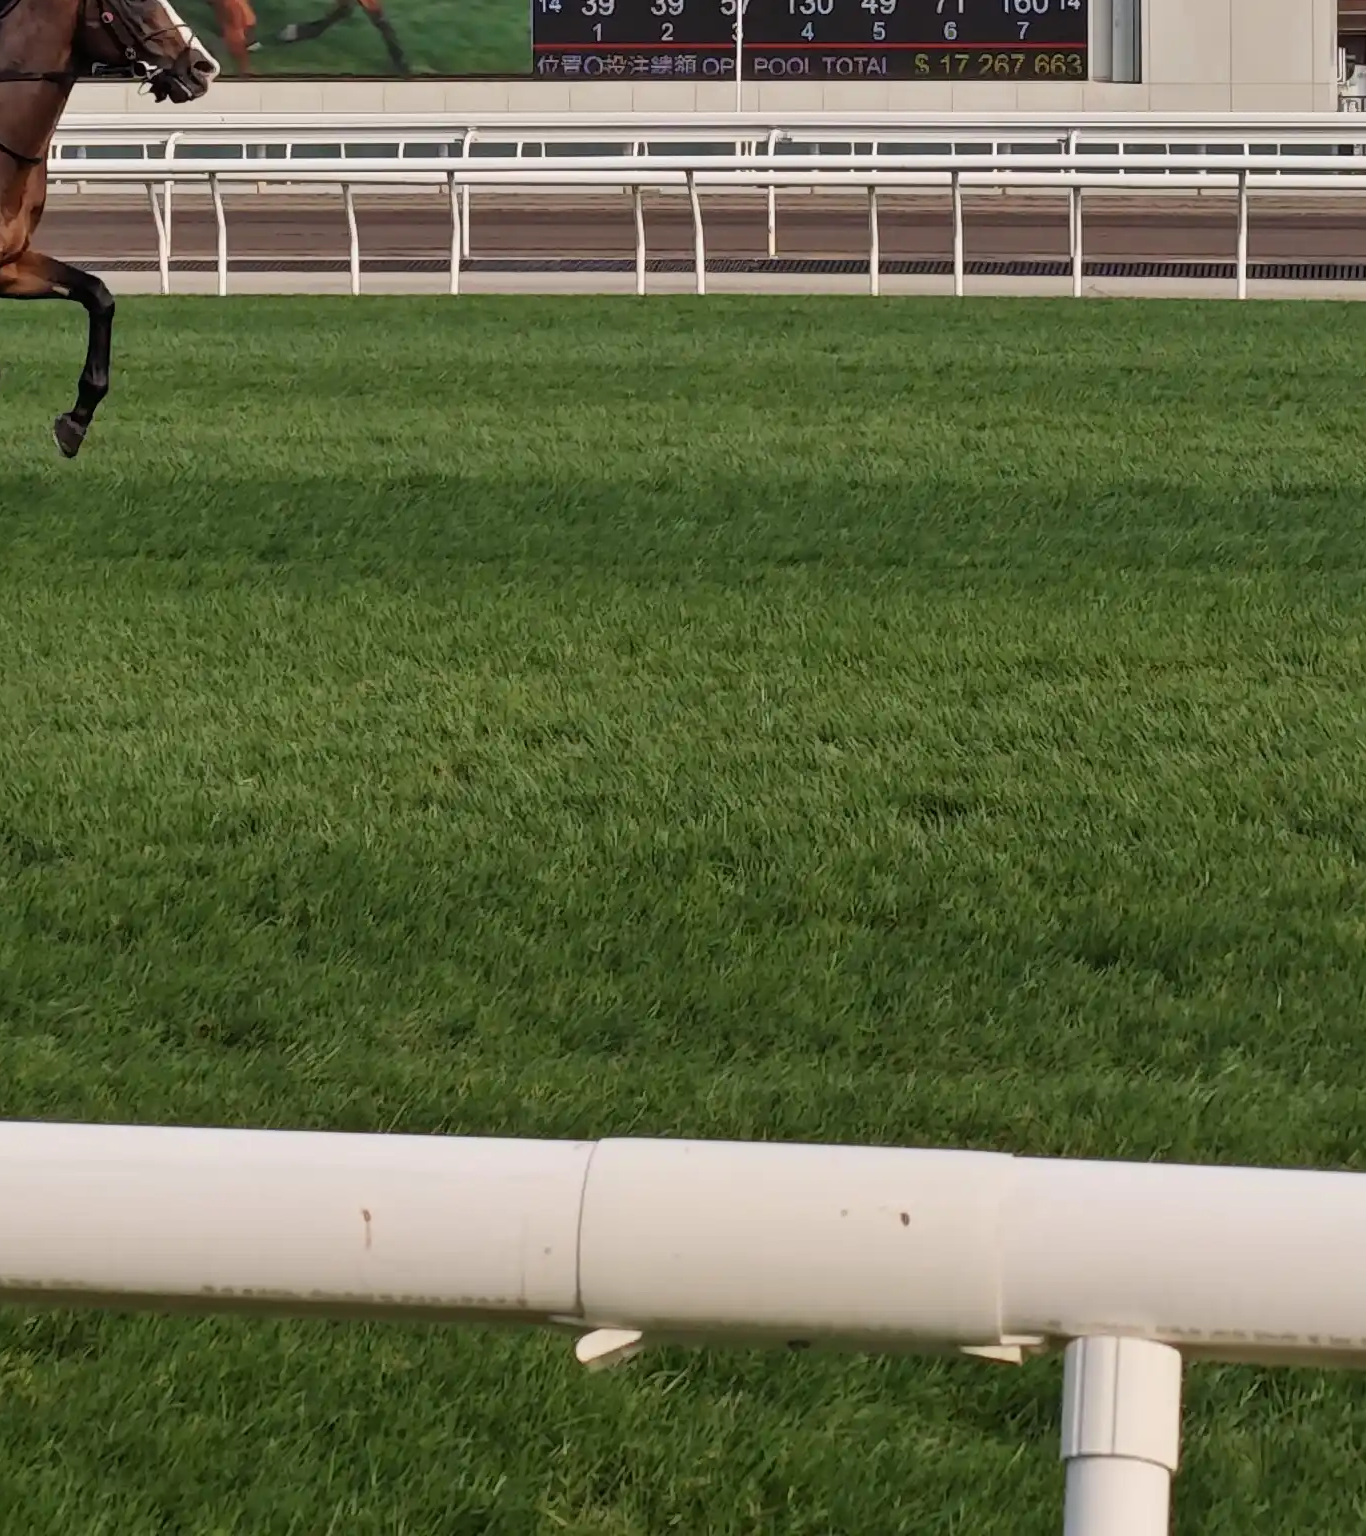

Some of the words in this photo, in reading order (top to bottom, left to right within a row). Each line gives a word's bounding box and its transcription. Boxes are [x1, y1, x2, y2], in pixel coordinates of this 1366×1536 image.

[593, 23, 601, 41] 1
[662, 23, 673, 40] 2
[801, 22, 814, 41] 4
[873, 22, 885, 40] 5
[944, 22, 957, 39] 6
[1017, 22, 1029, 39] 7
